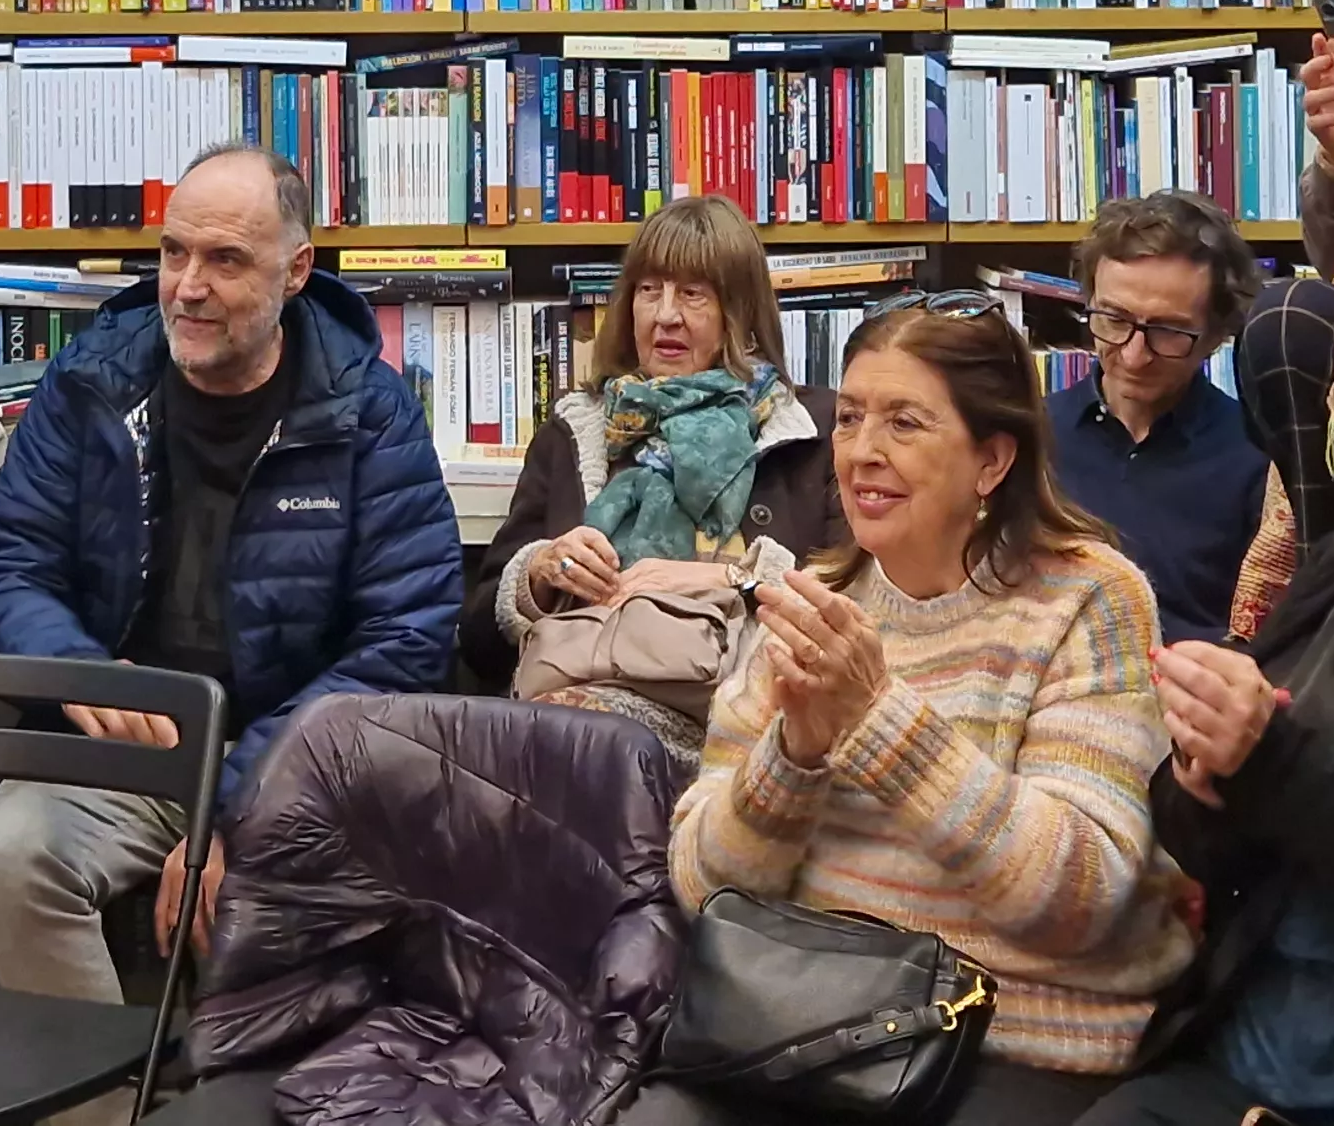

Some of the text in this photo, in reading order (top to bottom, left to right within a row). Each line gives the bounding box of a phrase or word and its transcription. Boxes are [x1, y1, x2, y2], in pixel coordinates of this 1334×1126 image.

[411, 254, 438, 265] CARL
[448, 312, 458, 425] FERNANDO FERNÁN GÓMEZ
[289, 496, 342, 510] Columbia
